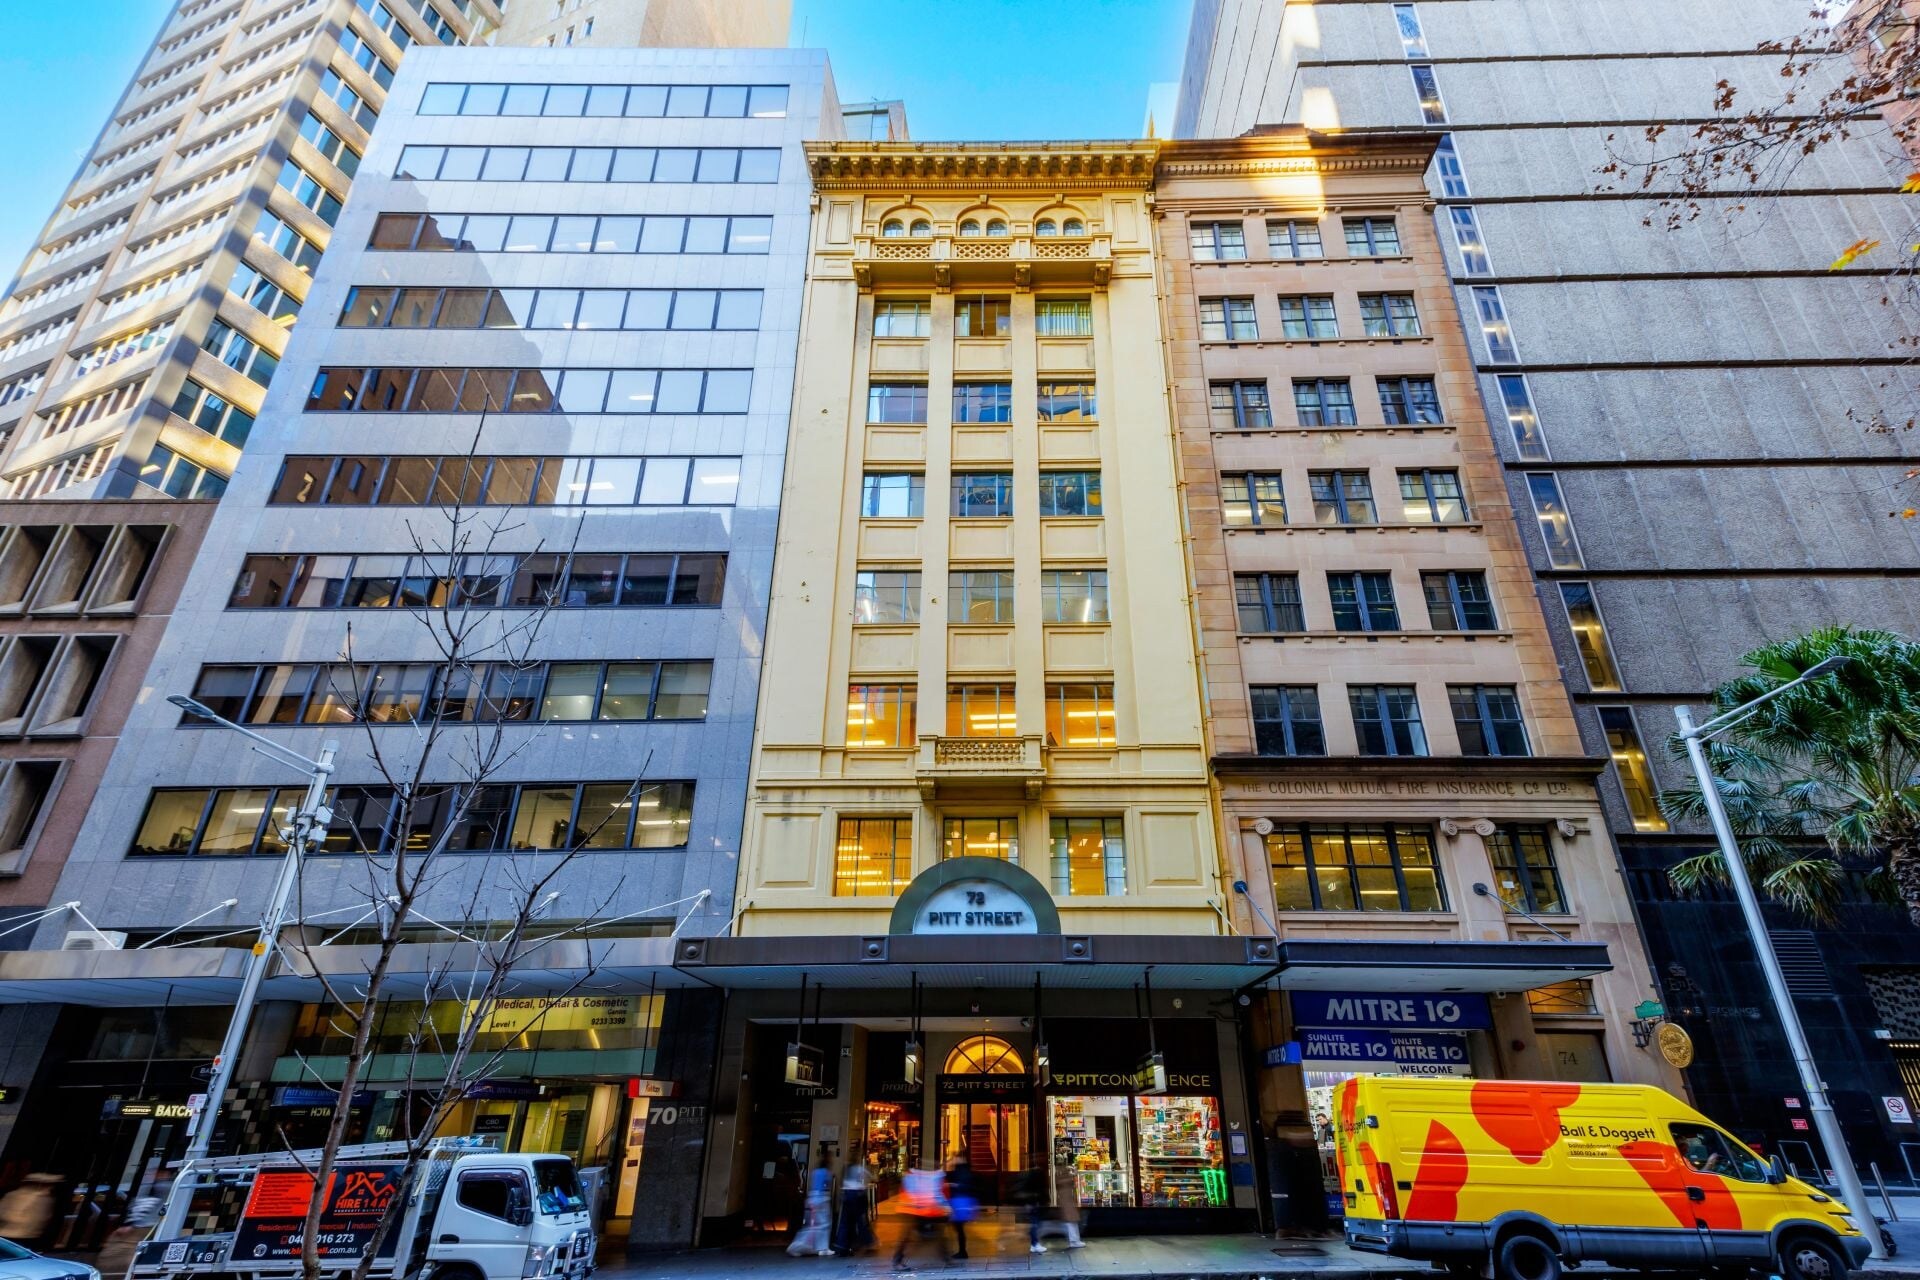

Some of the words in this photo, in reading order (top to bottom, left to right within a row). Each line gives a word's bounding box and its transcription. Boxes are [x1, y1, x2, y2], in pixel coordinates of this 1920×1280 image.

[1241, 783, 1262, 793] THE
[1268, 781, 1334, 795] COLONIAL
[1339, 781, 1393, 795] MUTUAL
[1399, 781, 1429, 795] FIRE
[1437, 781, 1515, 795] INSURANCE
[966, 891, 986, 905] 72
[928, 911, 962, 926] PITT
[965, 911, 1023, 926] STREET
[582, 997, 629, 1008] Cosmetic
[1326, 998, 1417, 1022] MITRE
[1424, 1000, 1461, 1022] 10
[491, 1021, 511, 1029] Level
[512, 1020, 516, 1028] 1
[1306, 1033, 1345, 1042] SUNLITE
[1391, 1037, 1422, 1046] UNLITE
[1306, 1042, 1361, 1056] MITRE
[1365, 1043, 1388, 1057] 10
[1441, 1047, 1463, 1060] 10
[1558, 1051, 1578, 1065] 74
[1400, 1065, 1453, 1074] WELCOME
[796, 1087, 835, 1096] minx
[943, 1081, 955, 1089] 72
[957, 1081, 981, 1089] PITT
[983, 1081, 1026, 1089] STREET
[155, 1104, 194, 1117] BATCH
[649, 1106, 678, 1125] 70
[679, 1106, 705, 1117] PITT
[1559, 1124, 1586, 1137] Ball
[1588, 1125, 1598, 1137] &
[1599, 1126, 1656, 1142] Doggett
[335, 1198, 362, 1209] HIRE
[335, 1233, 355, 1243] 273
